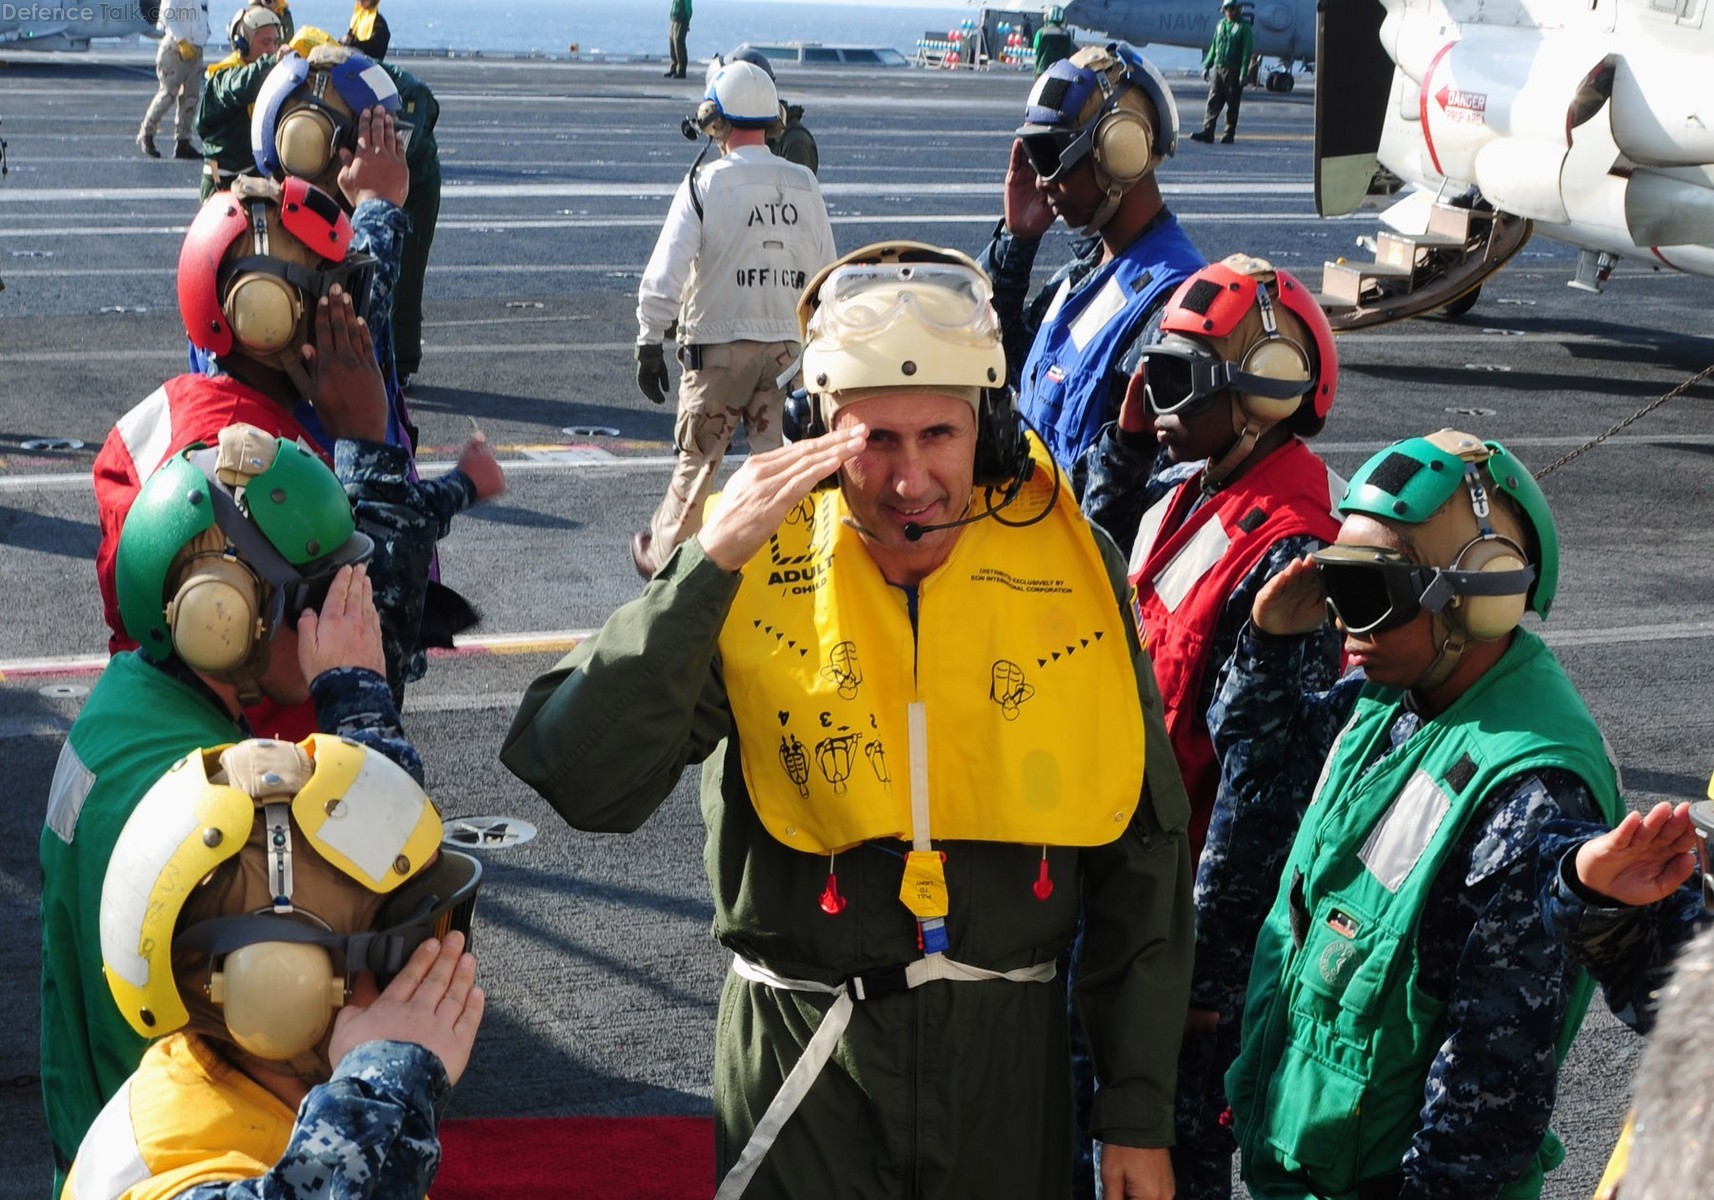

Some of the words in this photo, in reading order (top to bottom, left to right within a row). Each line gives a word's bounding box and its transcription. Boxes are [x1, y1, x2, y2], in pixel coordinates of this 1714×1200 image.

[1160, 13, 1210, 31] NAVY
[1448, 90, 1485, 111] DANGER
[748, 203, 798, 227] ATO
[737, 268, 806, 289] OFFICER
[768, 554, 835, 585] ADULT
[819, 711, 833, 728] 3
